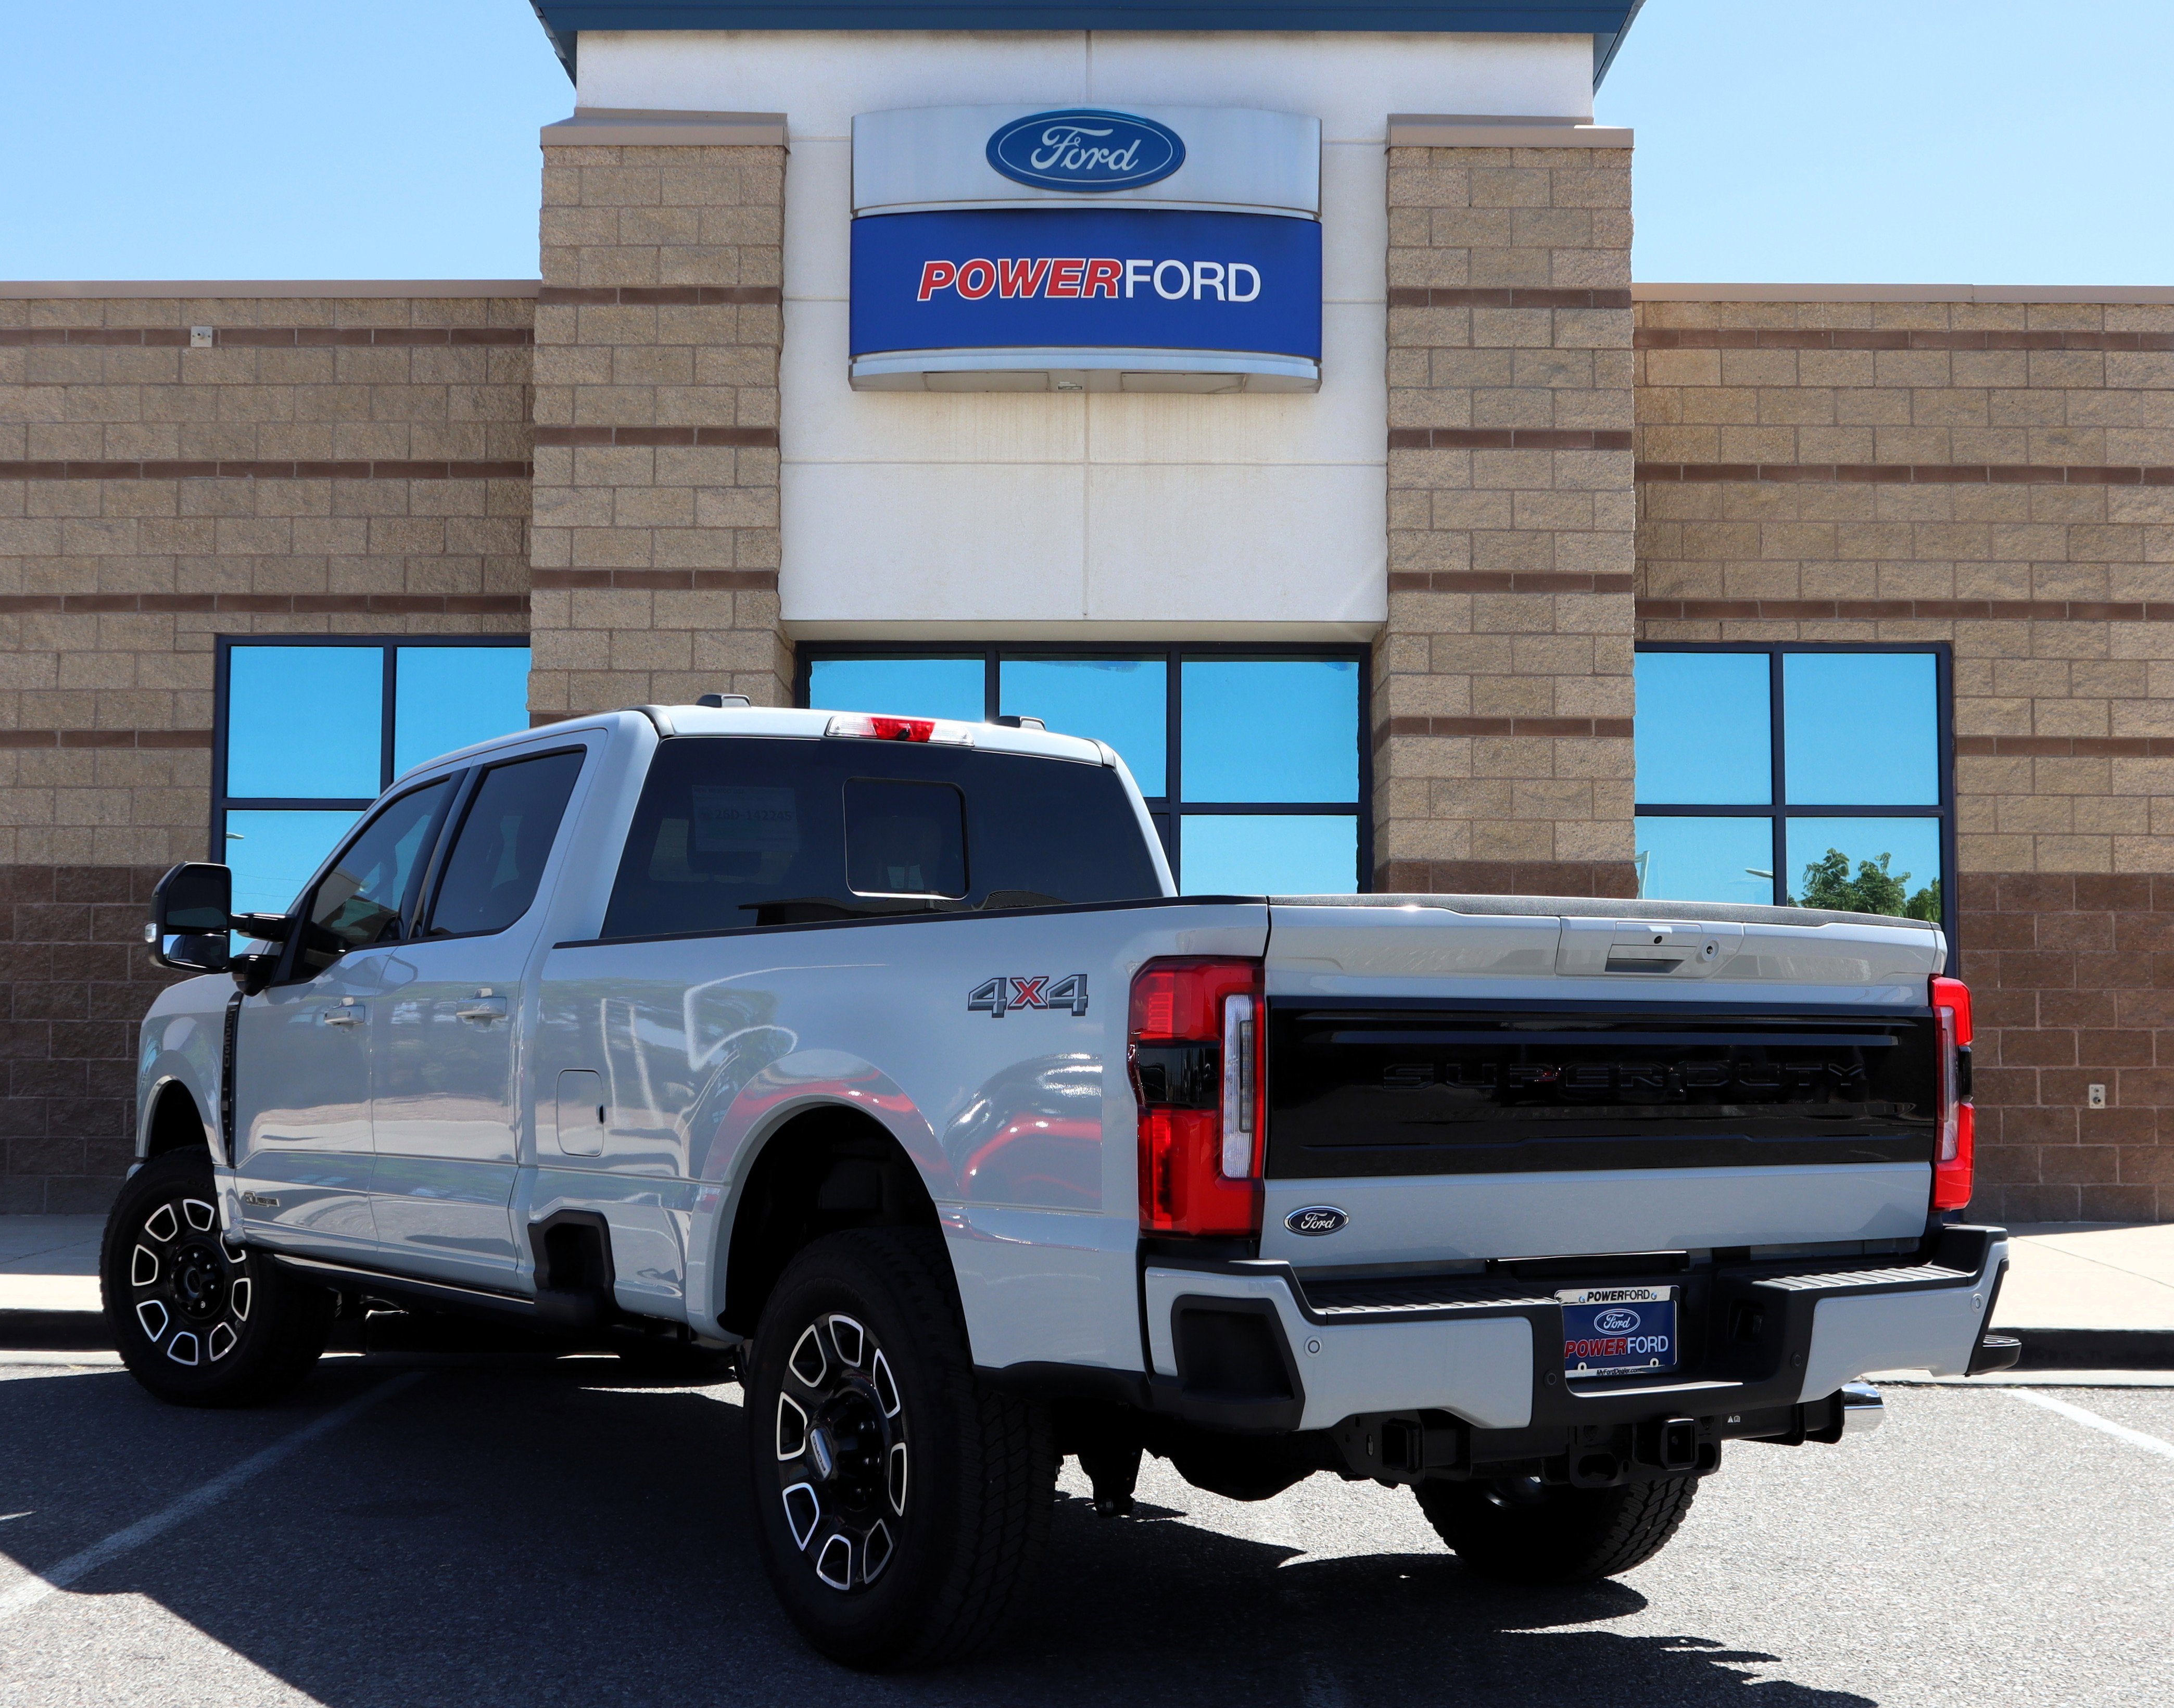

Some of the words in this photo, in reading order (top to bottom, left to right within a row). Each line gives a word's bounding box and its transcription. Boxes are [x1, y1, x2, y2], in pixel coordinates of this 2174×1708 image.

[1031, 125, 1141, 171] Ford
[916, 258, 1261, 302] POWERFORD
[1383, 1062, 1664, 1090] SUPER
[1687, 1059, 1864, 1087] DUTY
[1300, 1212, 1336, 1230] Ford
[1587, 1289, 1650, 1302] POWERFORD
[1603, 1313, 1630, 1329] Ford
[1564, 1335, 1669, 1359] POWERFORD
